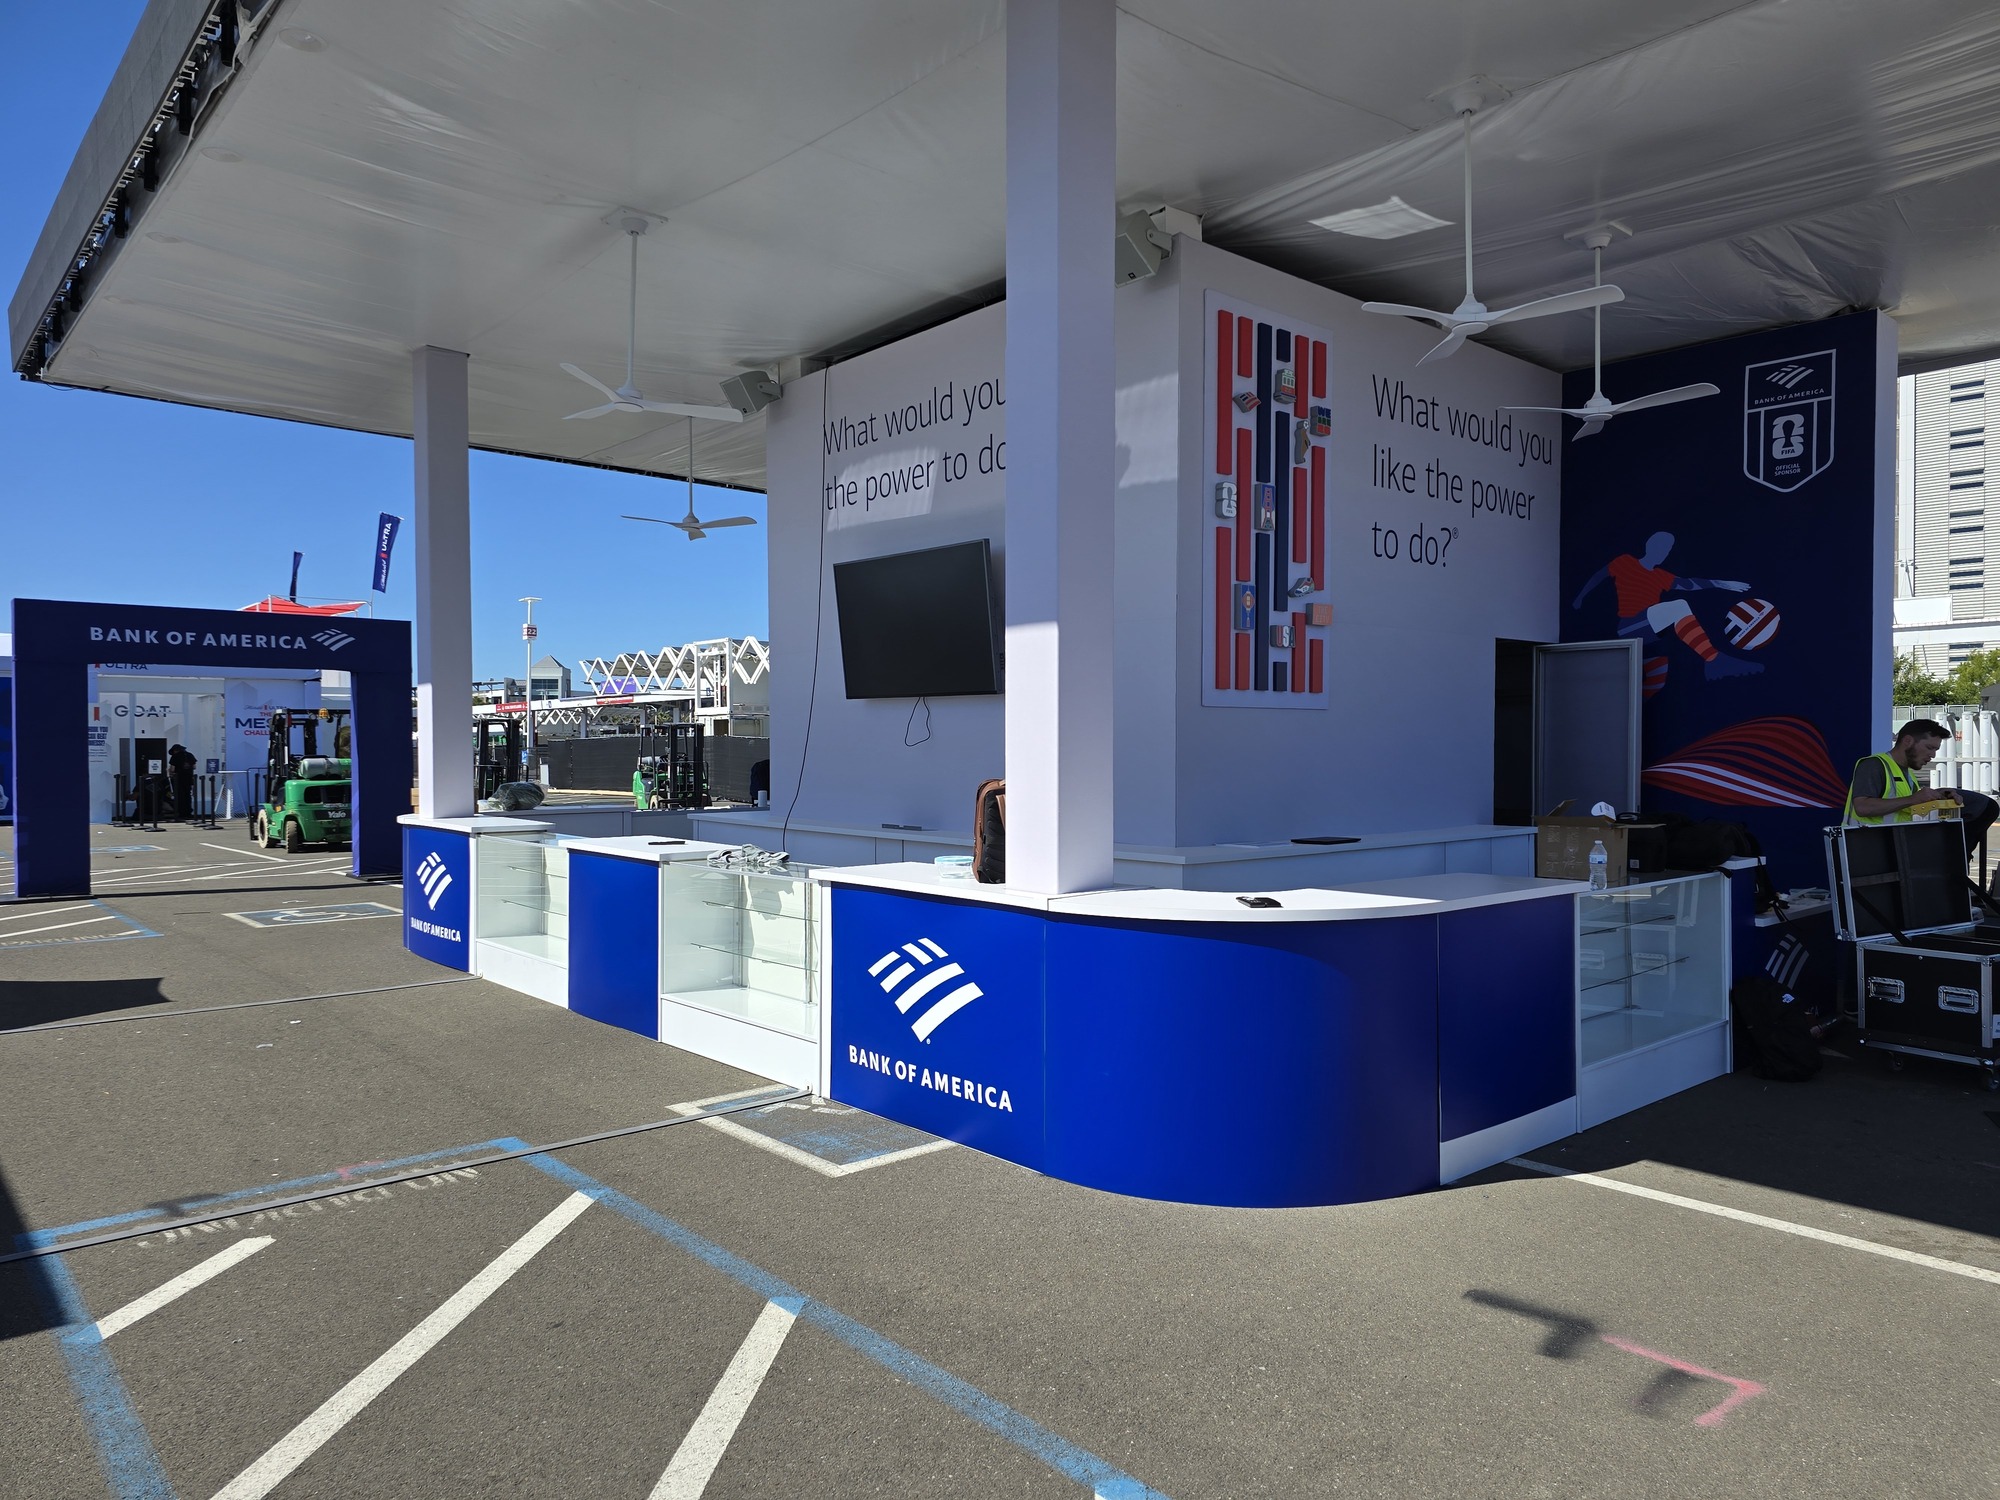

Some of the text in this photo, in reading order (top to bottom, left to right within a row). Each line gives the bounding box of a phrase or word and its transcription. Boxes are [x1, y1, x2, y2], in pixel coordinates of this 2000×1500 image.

[1754, 396, 1775, 405] BANK
[1788, 388, 1825, 398] AMERICA
[824, 412, 878, 455] What
[884, 381, 953, 438] would
[1372, 374, 1552, 468] What would you
[1781, 448, 1796, 456] FIFA
[1774, 468, 1801, 476] SPONSOR
[1775, 463, 1800, 471] OFFICIAL
[825, 476, 858, 510] the
[866, 460, 934, 512] power
[943, 451, 968, 482] to
[1373, 444, 1536, 520] like the power
[382, 522, 392, 551] ULTRA
[1372, 521, 1399, 560] to
[90, 626, 308, 650] BANK OF AMERICA
[1276, 624, 1296, 648] USA
[411, 917, 461, 942] BANK OF AMERICA
[849, 1044, 1012, 1112] BANK OF AMERICA
